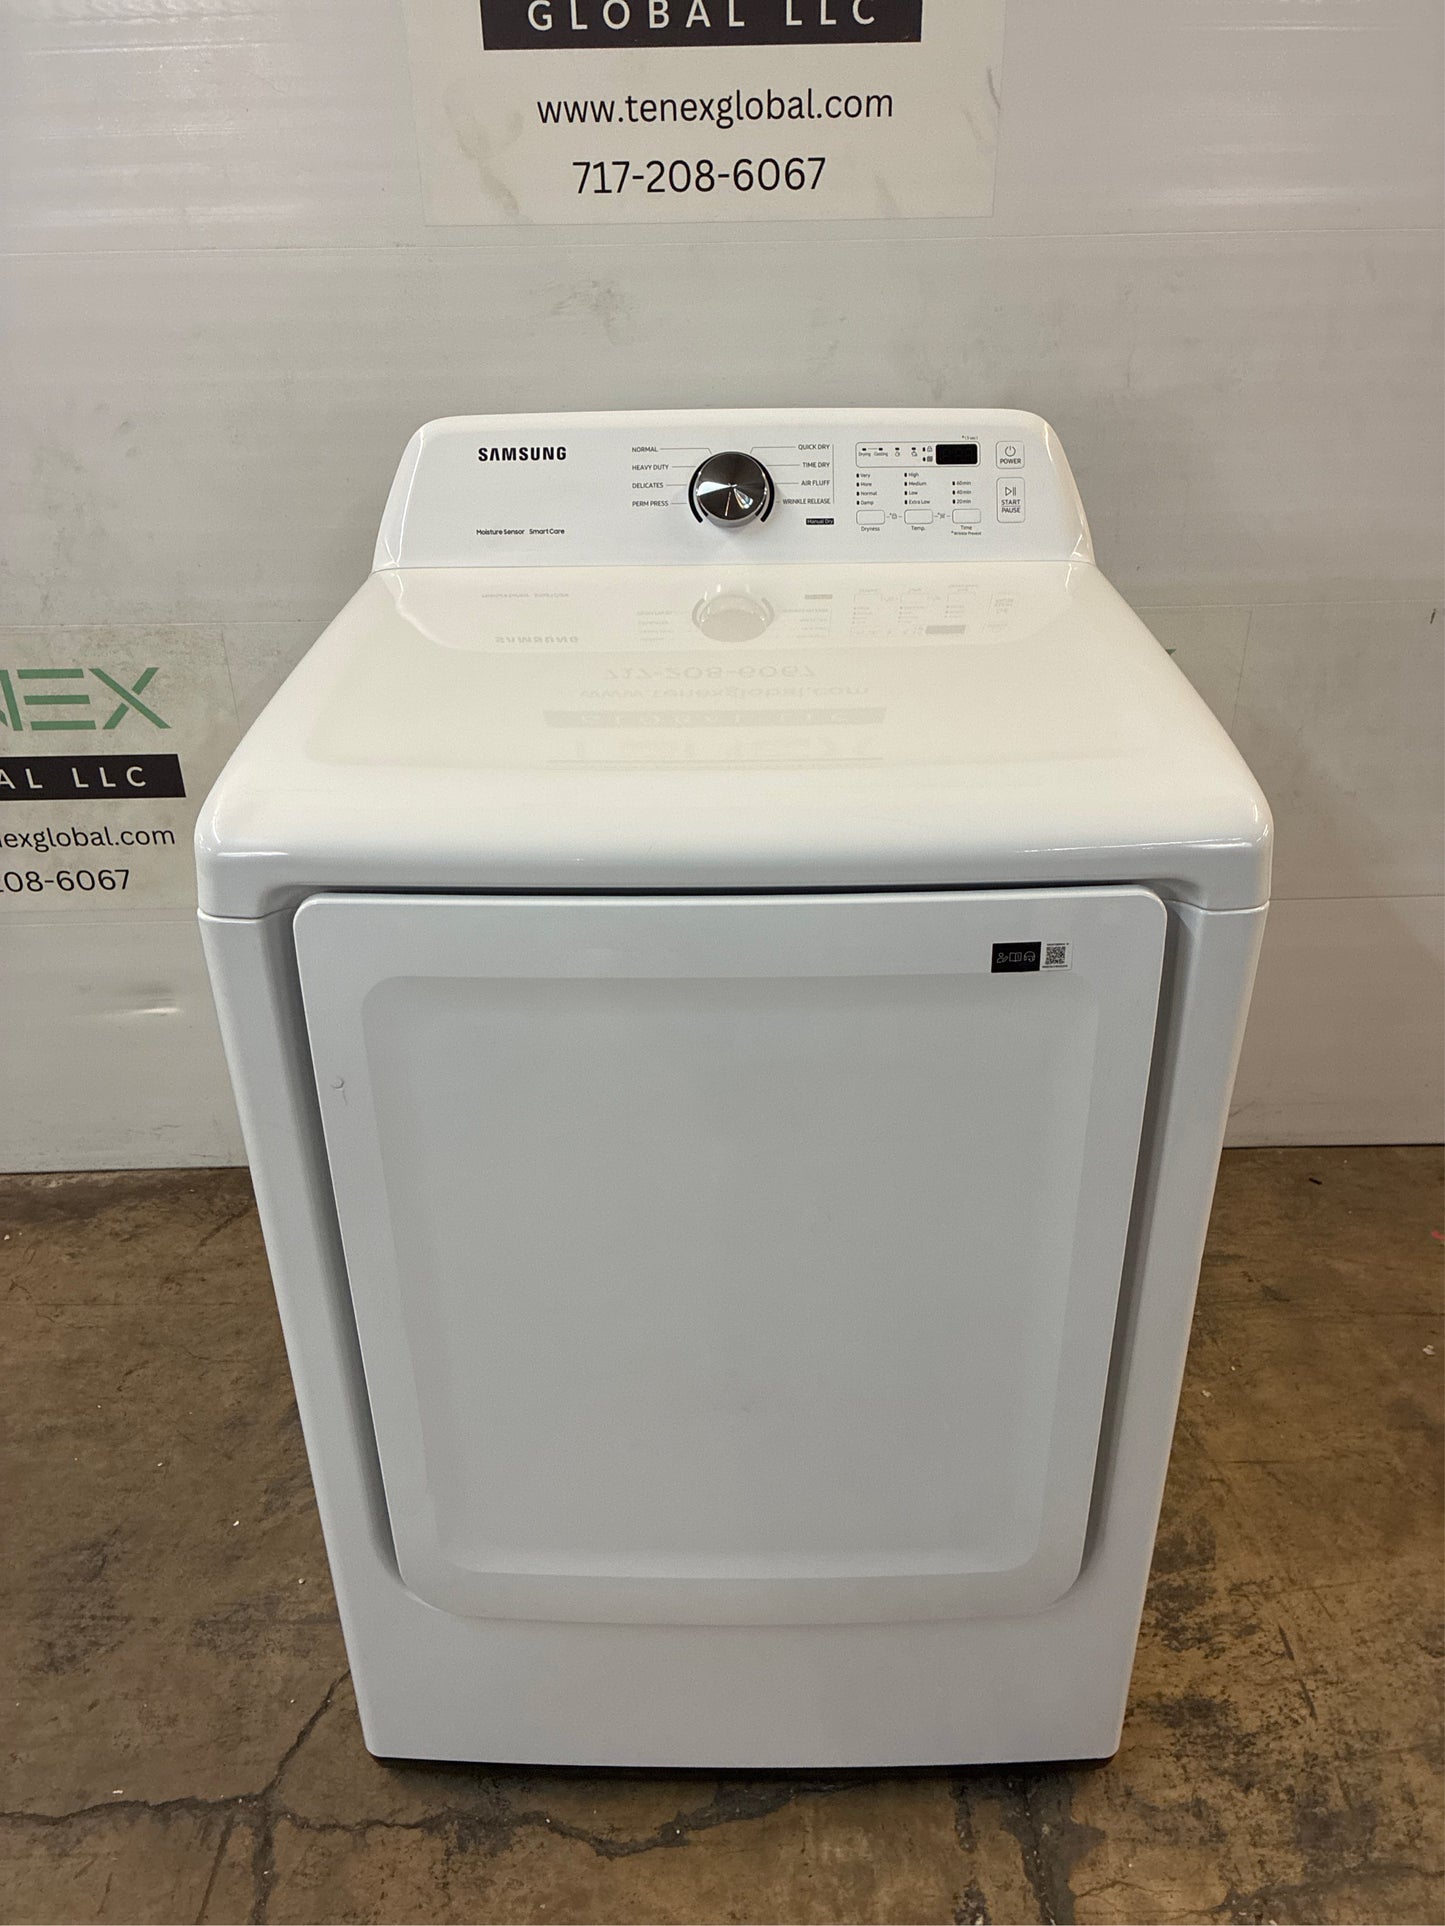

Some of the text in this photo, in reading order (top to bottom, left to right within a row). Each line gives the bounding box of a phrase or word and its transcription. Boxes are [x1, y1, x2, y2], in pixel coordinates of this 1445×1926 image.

[527, 0, 876, 31] GLOBAL LLC
[536, 88, 893, 129] www.tenexglobal.com
[572, 157, 826, 195] 717-208-6067
[477, 446, 567, 462] SAMSUNG
[798, 443, 830, 451] QUICK DRY
[802, 461, 830, 469] TIME DRY
[801, 479, 830, 487] AIR FLUFF
[782, 497, 831, 505] WRINKLE RELEASE
[1001, 498, 1021, 506] START
[71, 766, 147, 789] LLC
[0, 826, 175, 853] exglobal.com
[0, 869, 130, 893] 08-6067
